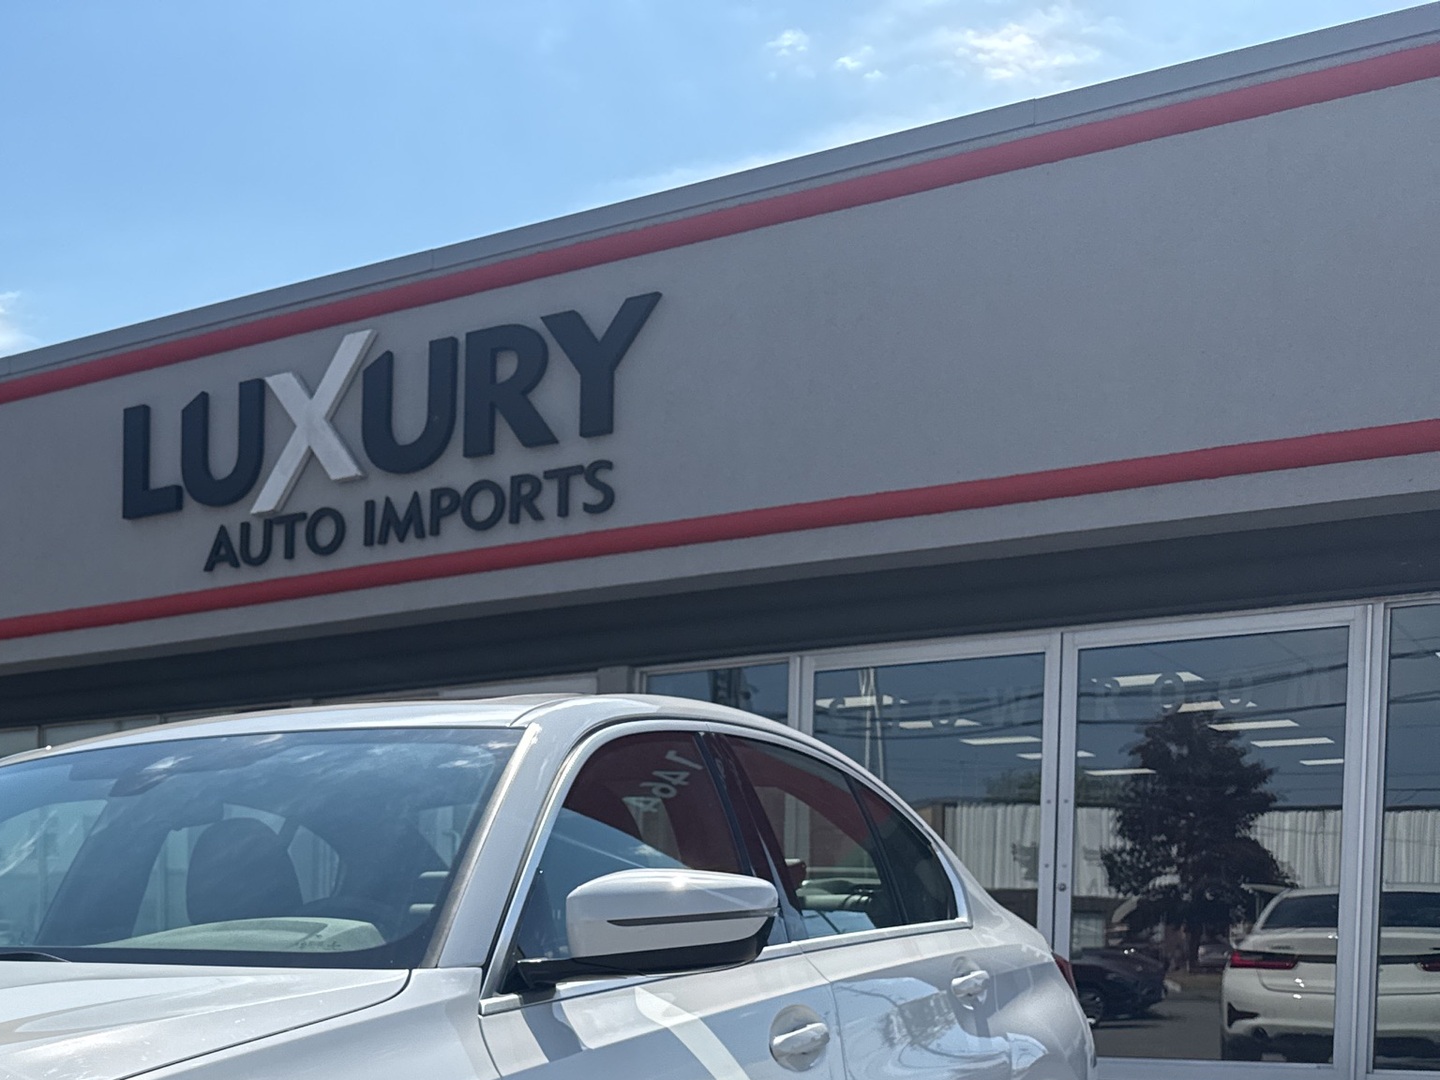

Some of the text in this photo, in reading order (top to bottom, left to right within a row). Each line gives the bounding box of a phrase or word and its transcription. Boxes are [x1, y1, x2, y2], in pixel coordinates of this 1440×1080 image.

[122, 291, 663, 521] LUXURY
[203, 459, 616, 572] AUTO IMPORTS
